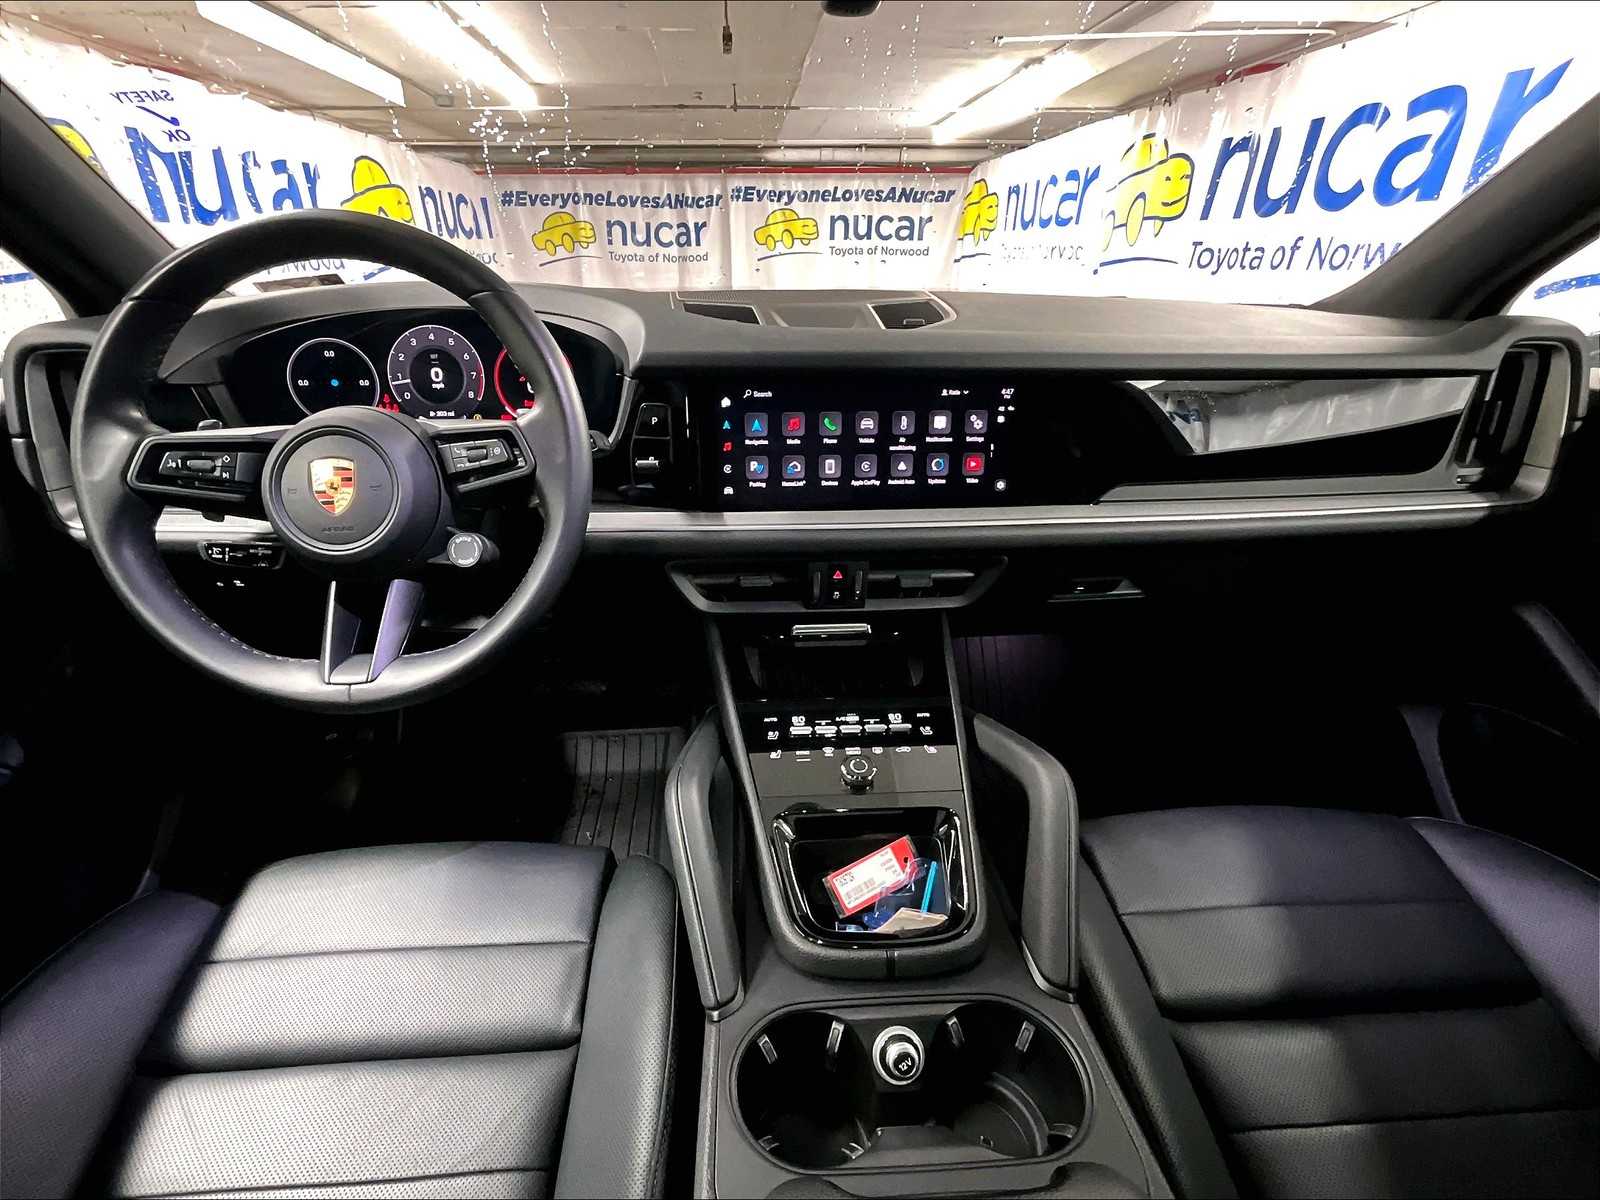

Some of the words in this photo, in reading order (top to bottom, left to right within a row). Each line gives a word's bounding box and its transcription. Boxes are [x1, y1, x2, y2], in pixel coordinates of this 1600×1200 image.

[1199, 58, 1574, 220] nucar
[501, 190, 723, 209] #EveryoneLovesANucar
[730, 186, 956, 206] #EveryoneLovesANucar
[1004, 165, 1101, 231] nucar
[606, 219, 707, 248] nucar
[829, 214, 933, 241] nucar
[608, 251, 645, 263] Toyota
[648, 253, 659, 262] of
[663, 252, 709, 263] Norwood
[829, 246, 864, 258] Toyota
[867, 245, 878, 255] of
[881, 246, 929, 257] Norwood
[1189, 241, 1265, 275] Toyota
[1270, 236, 1304, 270] of
[410, 338, 417, 346] 3
[428, 332, 435, 341] 4
[448, 337, 455, 346] 5
[398, 353, 405, 361] 2
[430, 367, 443, 382] 0
[470, 372, 476, 380] 7
[404, 391, 411, 399] 0
[468, 391, 474, 399] 8
[651, 416, 658, 425] P
[898, 1057, 912, 1072] 12V
